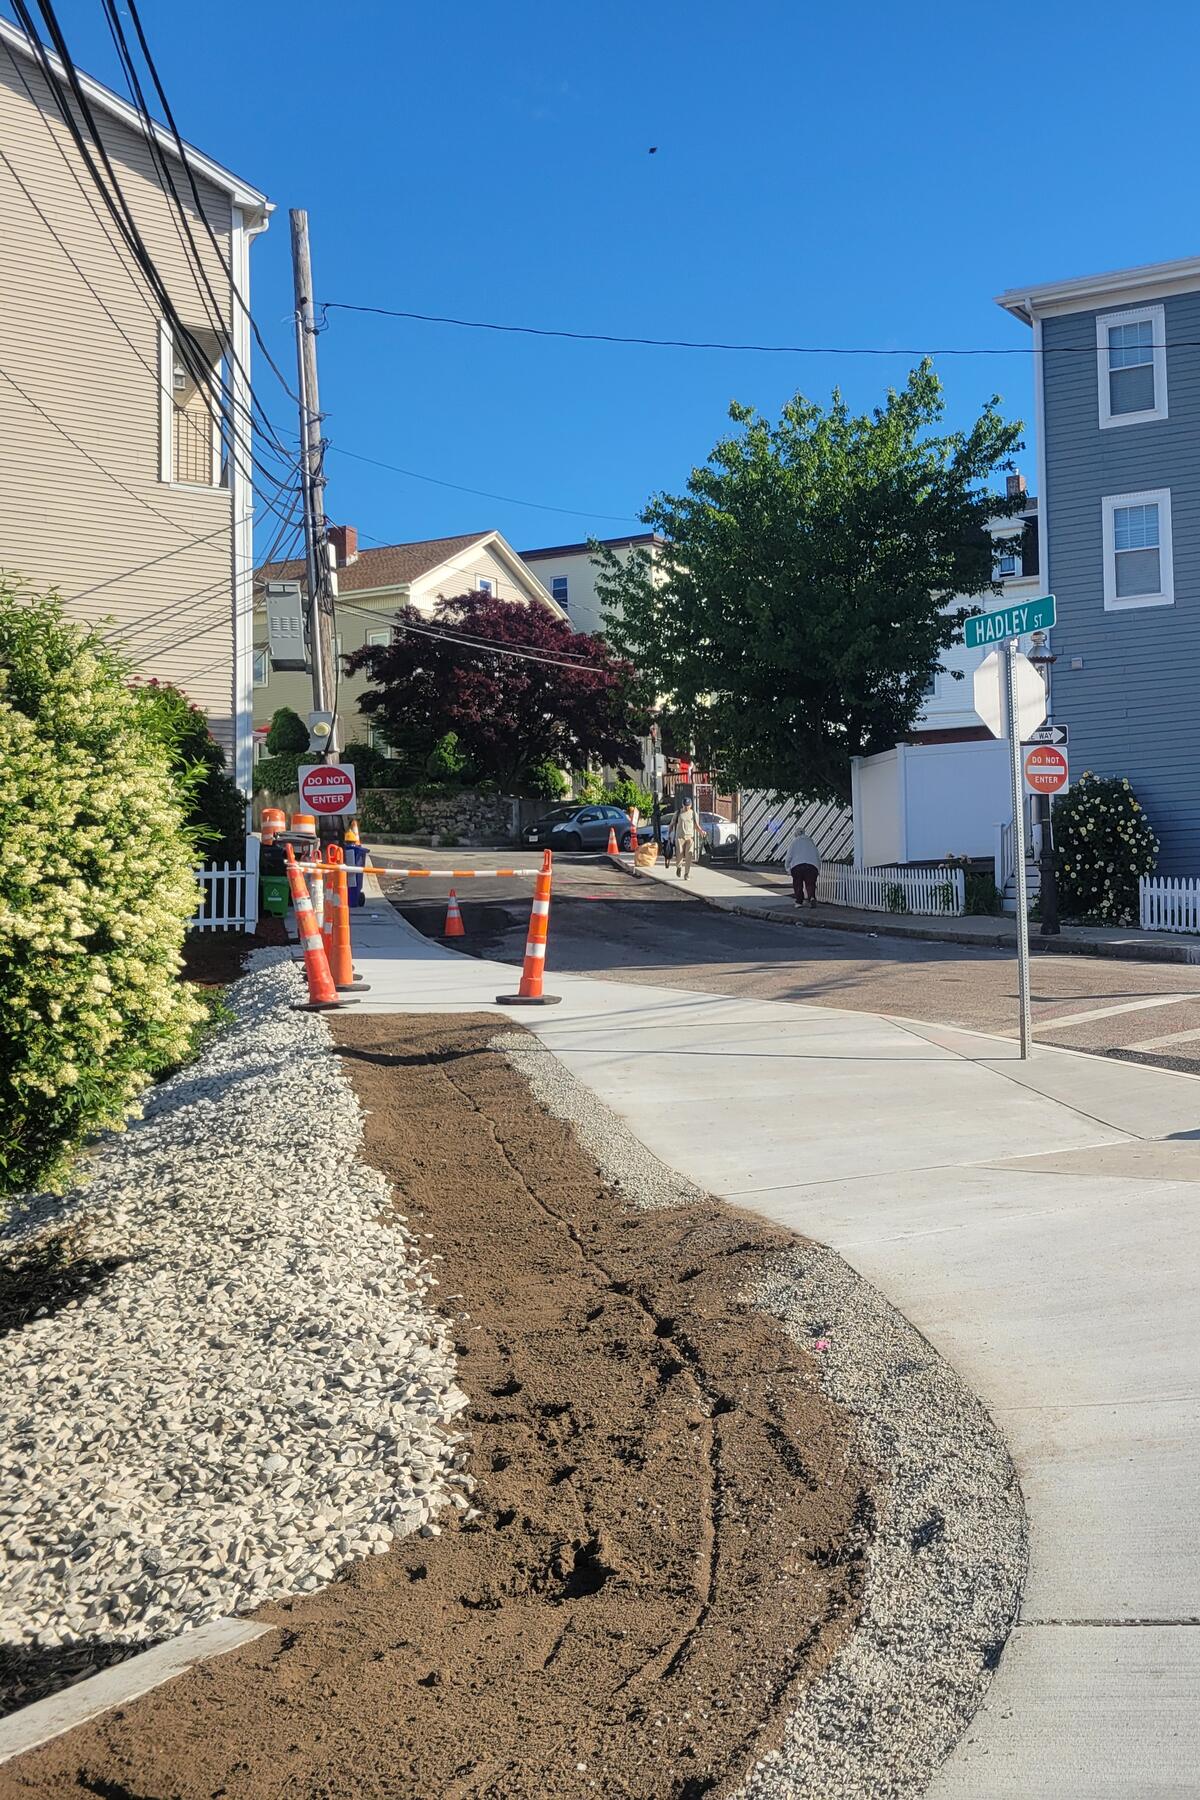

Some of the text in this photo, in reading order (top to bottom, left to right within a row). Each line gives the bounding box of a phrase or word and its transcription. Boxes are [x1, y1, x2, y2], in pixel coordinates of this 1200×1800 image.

[976, 608, 1043, 643] HADLEY ST
[1039, 732, 1053, 740] WAY
[1032, 756, 1060, 764] DO NOT
[307, 776, 346, 785] DO NOT
[312, 795, 345, 804] ENTER
